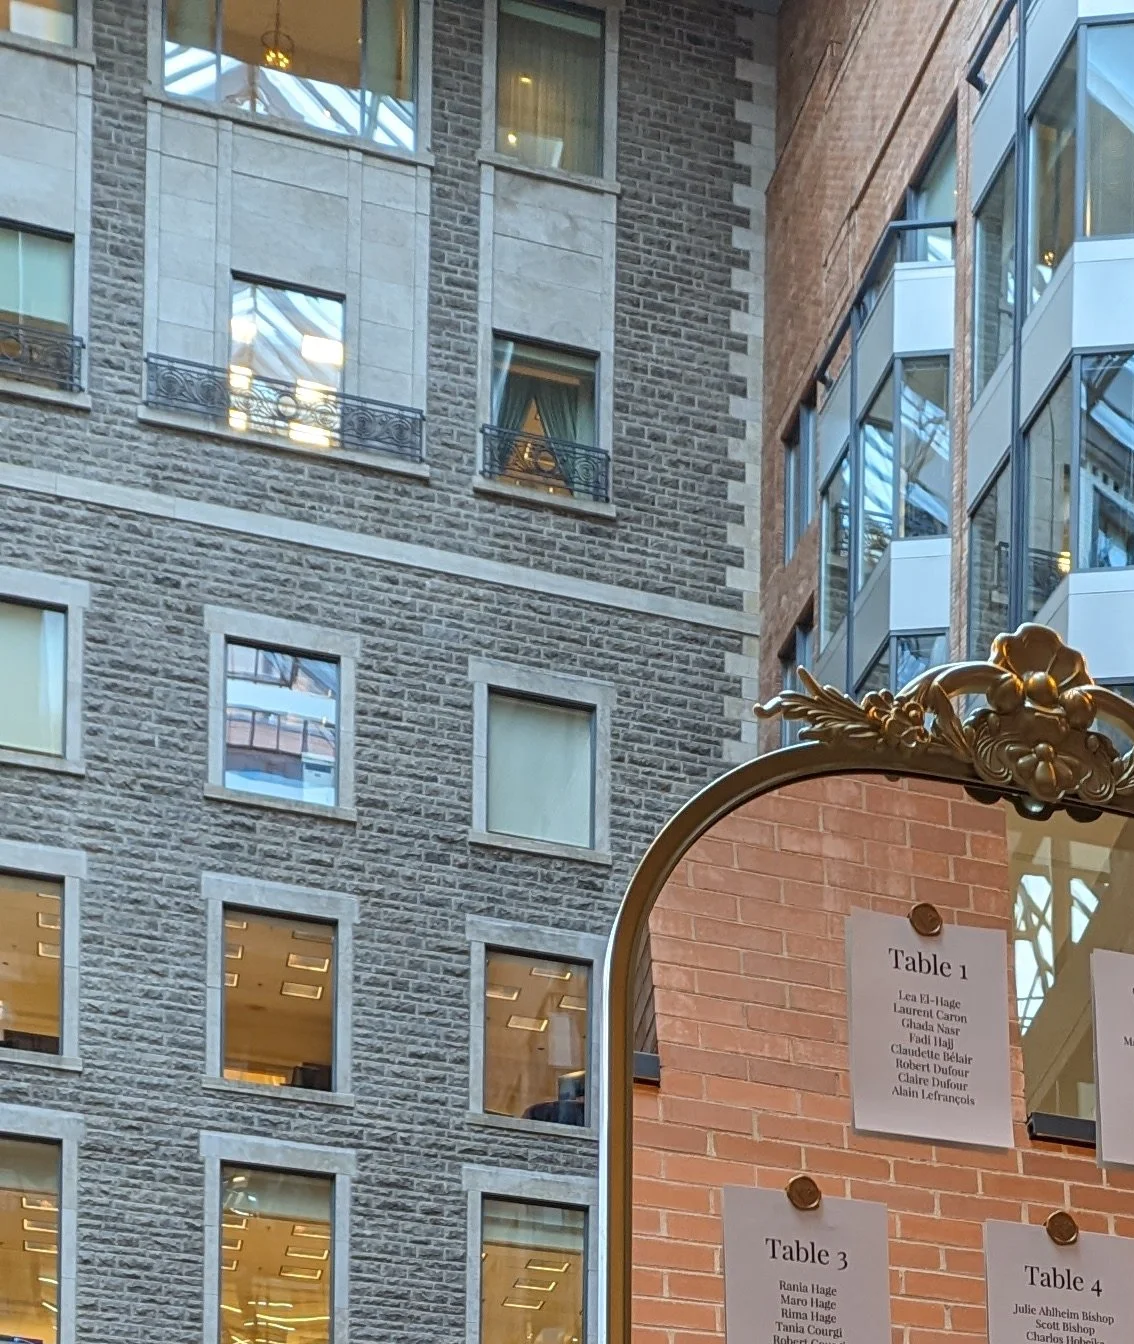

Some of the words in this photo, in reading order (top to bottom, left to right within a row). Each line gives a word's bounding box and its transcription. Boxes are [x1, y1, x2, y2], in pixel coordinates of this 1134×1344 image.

[888, 947, 952, 978] Table
[960, 965, 968, 980] 1
[894, 1002, 933, 1019] Laurent
[936, 1010, 967, 1024] Caron
[937, 1023, 960, 1036] Nasr
[896, 1058, 930, 1073] Robert
[934, 1064, 969, 1078] Dufour
[898, 1072, 929, 1086] Claire
[932, 1076, 968, 1091] Dufour
[765, 1238, 829, 1265] Table
[837, 1251, 848, 1270] 3
[780, 1280, 808, 1293] Rania
[812, 1284, 837, 1297] Hage
[1024, 1265, 1084, 1292] Table
[1091, 1280, 1102, 1297] 4
[781, 1294, 808, 1306] Maro
[811, 1297, 836, 1310] Hage
[775, 1321, 804, 1334] Tania
[807, 1324, 842, 1339] Courgi
[1036, 1319, 1060, 1330] Scott
[1062, 1322, 1095, 1336] Bishop
